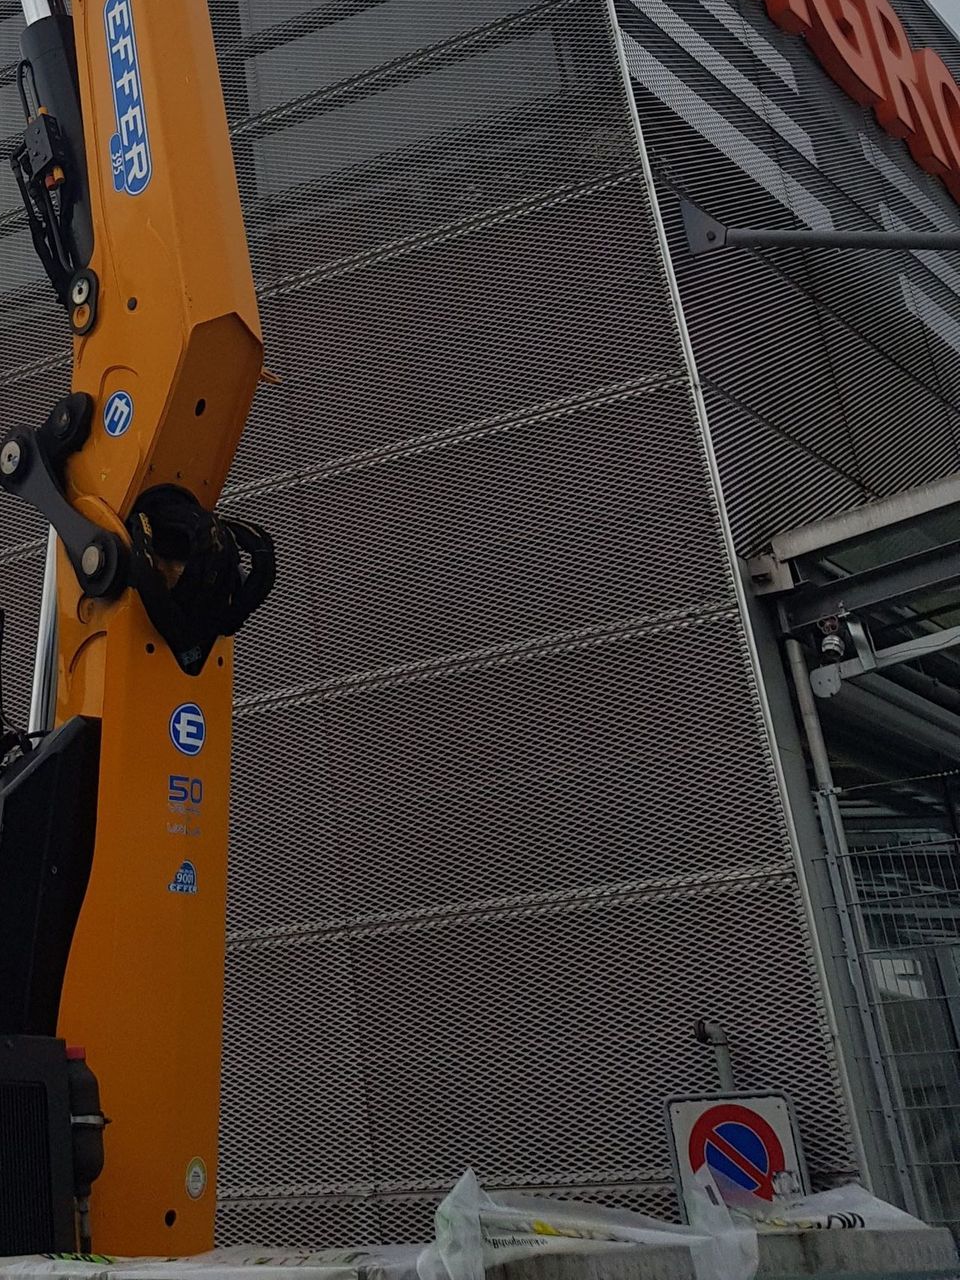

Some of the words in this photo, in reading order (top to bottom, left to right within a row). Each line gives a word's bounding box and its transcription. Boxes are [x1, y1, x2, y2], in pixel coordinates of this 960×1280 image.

[108, 1, 147, 186] EFFER
[112, 151, 123, 174] 395
[175, 712, 204, 747] E
[169, 775, 203, 804] 50
